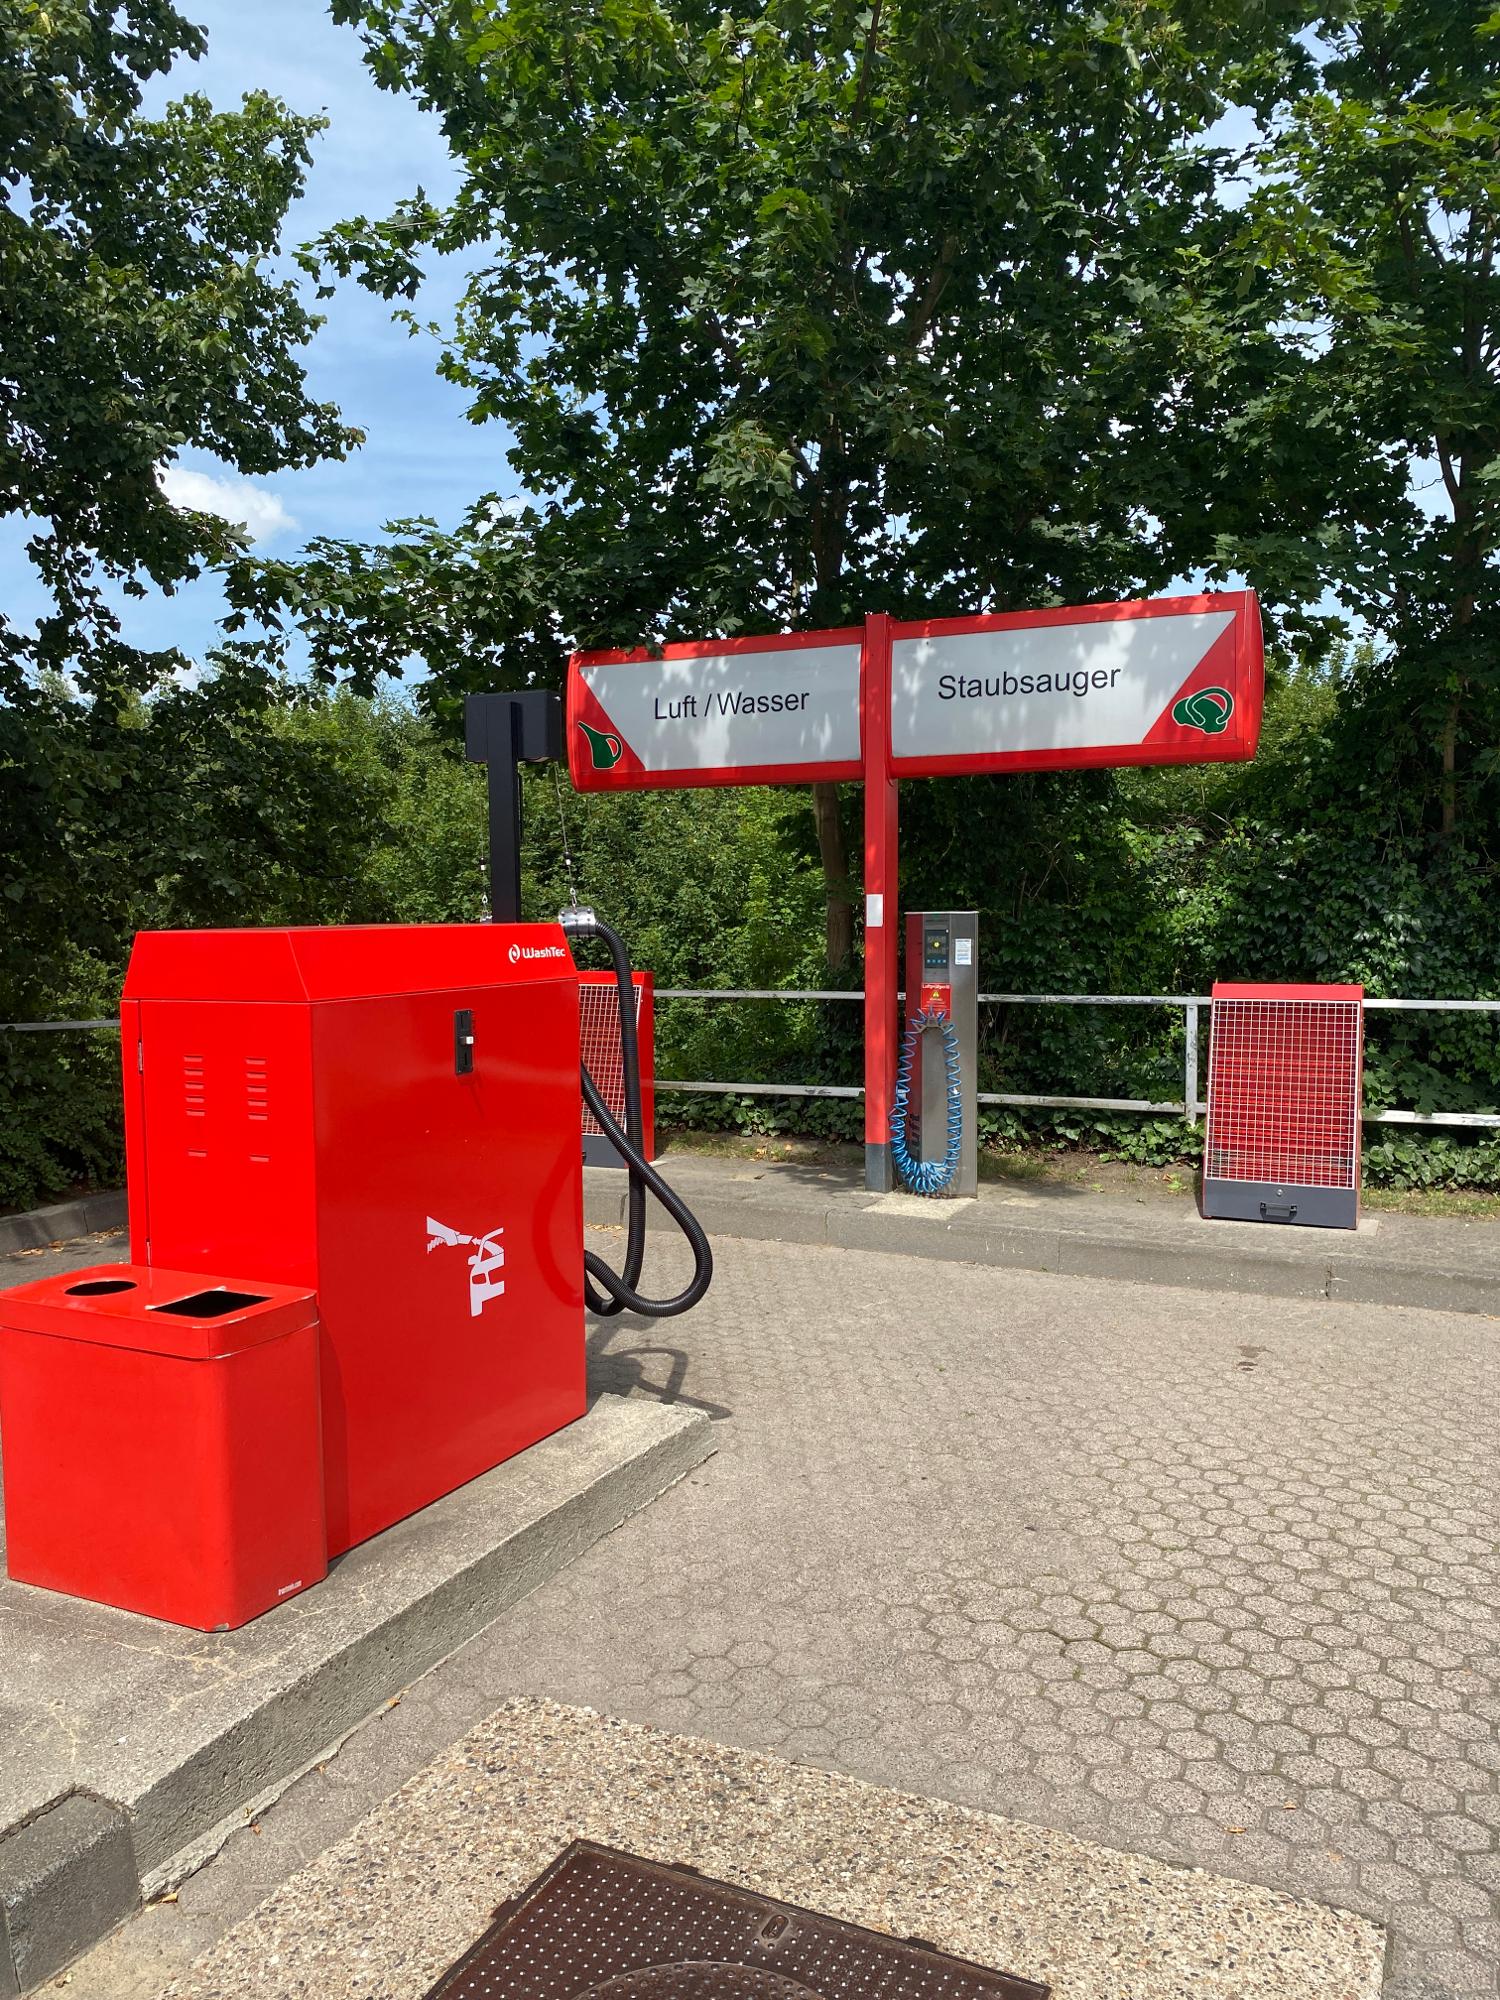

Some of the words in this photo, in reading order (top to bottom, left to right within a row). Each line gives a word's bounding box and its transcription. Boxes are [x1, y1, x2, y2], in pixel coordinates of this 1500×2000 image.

[938, 668, 1121, 700] Staubsauger
[654, 695, 697, 720] Luft
[717, 691, 810, 715] Wasser
[522, 946, 566, 959] WashTec
